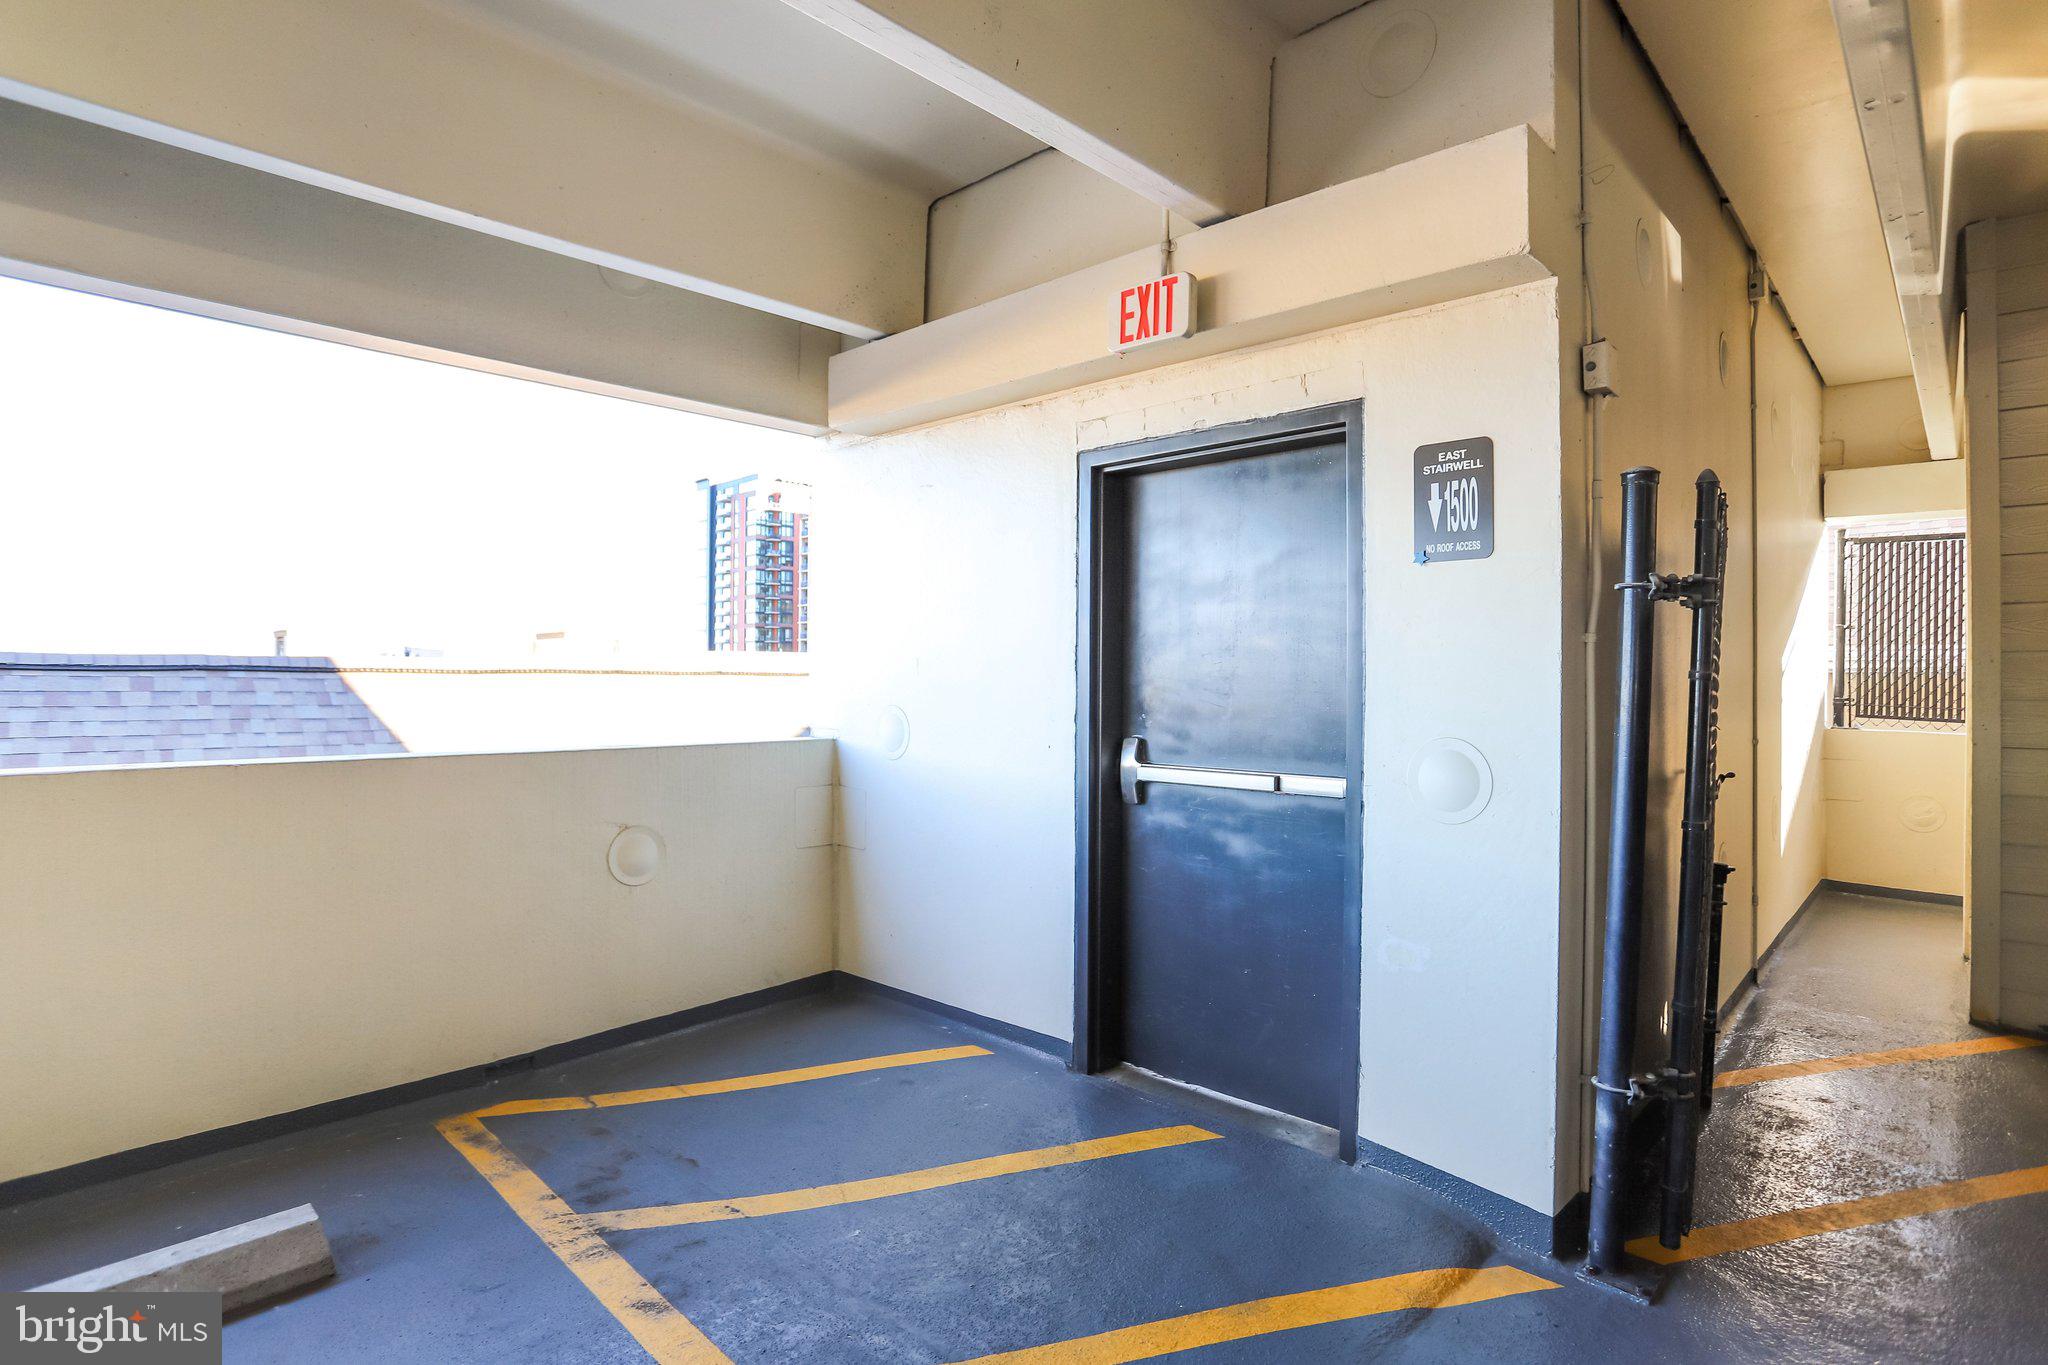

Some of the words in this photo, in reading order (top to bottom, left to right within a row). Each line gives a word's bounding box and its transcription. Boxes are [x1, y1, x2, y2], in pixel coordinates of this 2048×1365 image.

[1120, 276, 1178, 344] EXIT
[1438, 449, 1467, 462] EAST
[1423, 459, 1484, 475] STAIRWELL
[1444, 476, 1479, 532] 1500
[1425, 544, 1435, 554] NO
[1437, 542, 1454, 553] ROOF
[1455, 541, 1481, 551] ACCESS
